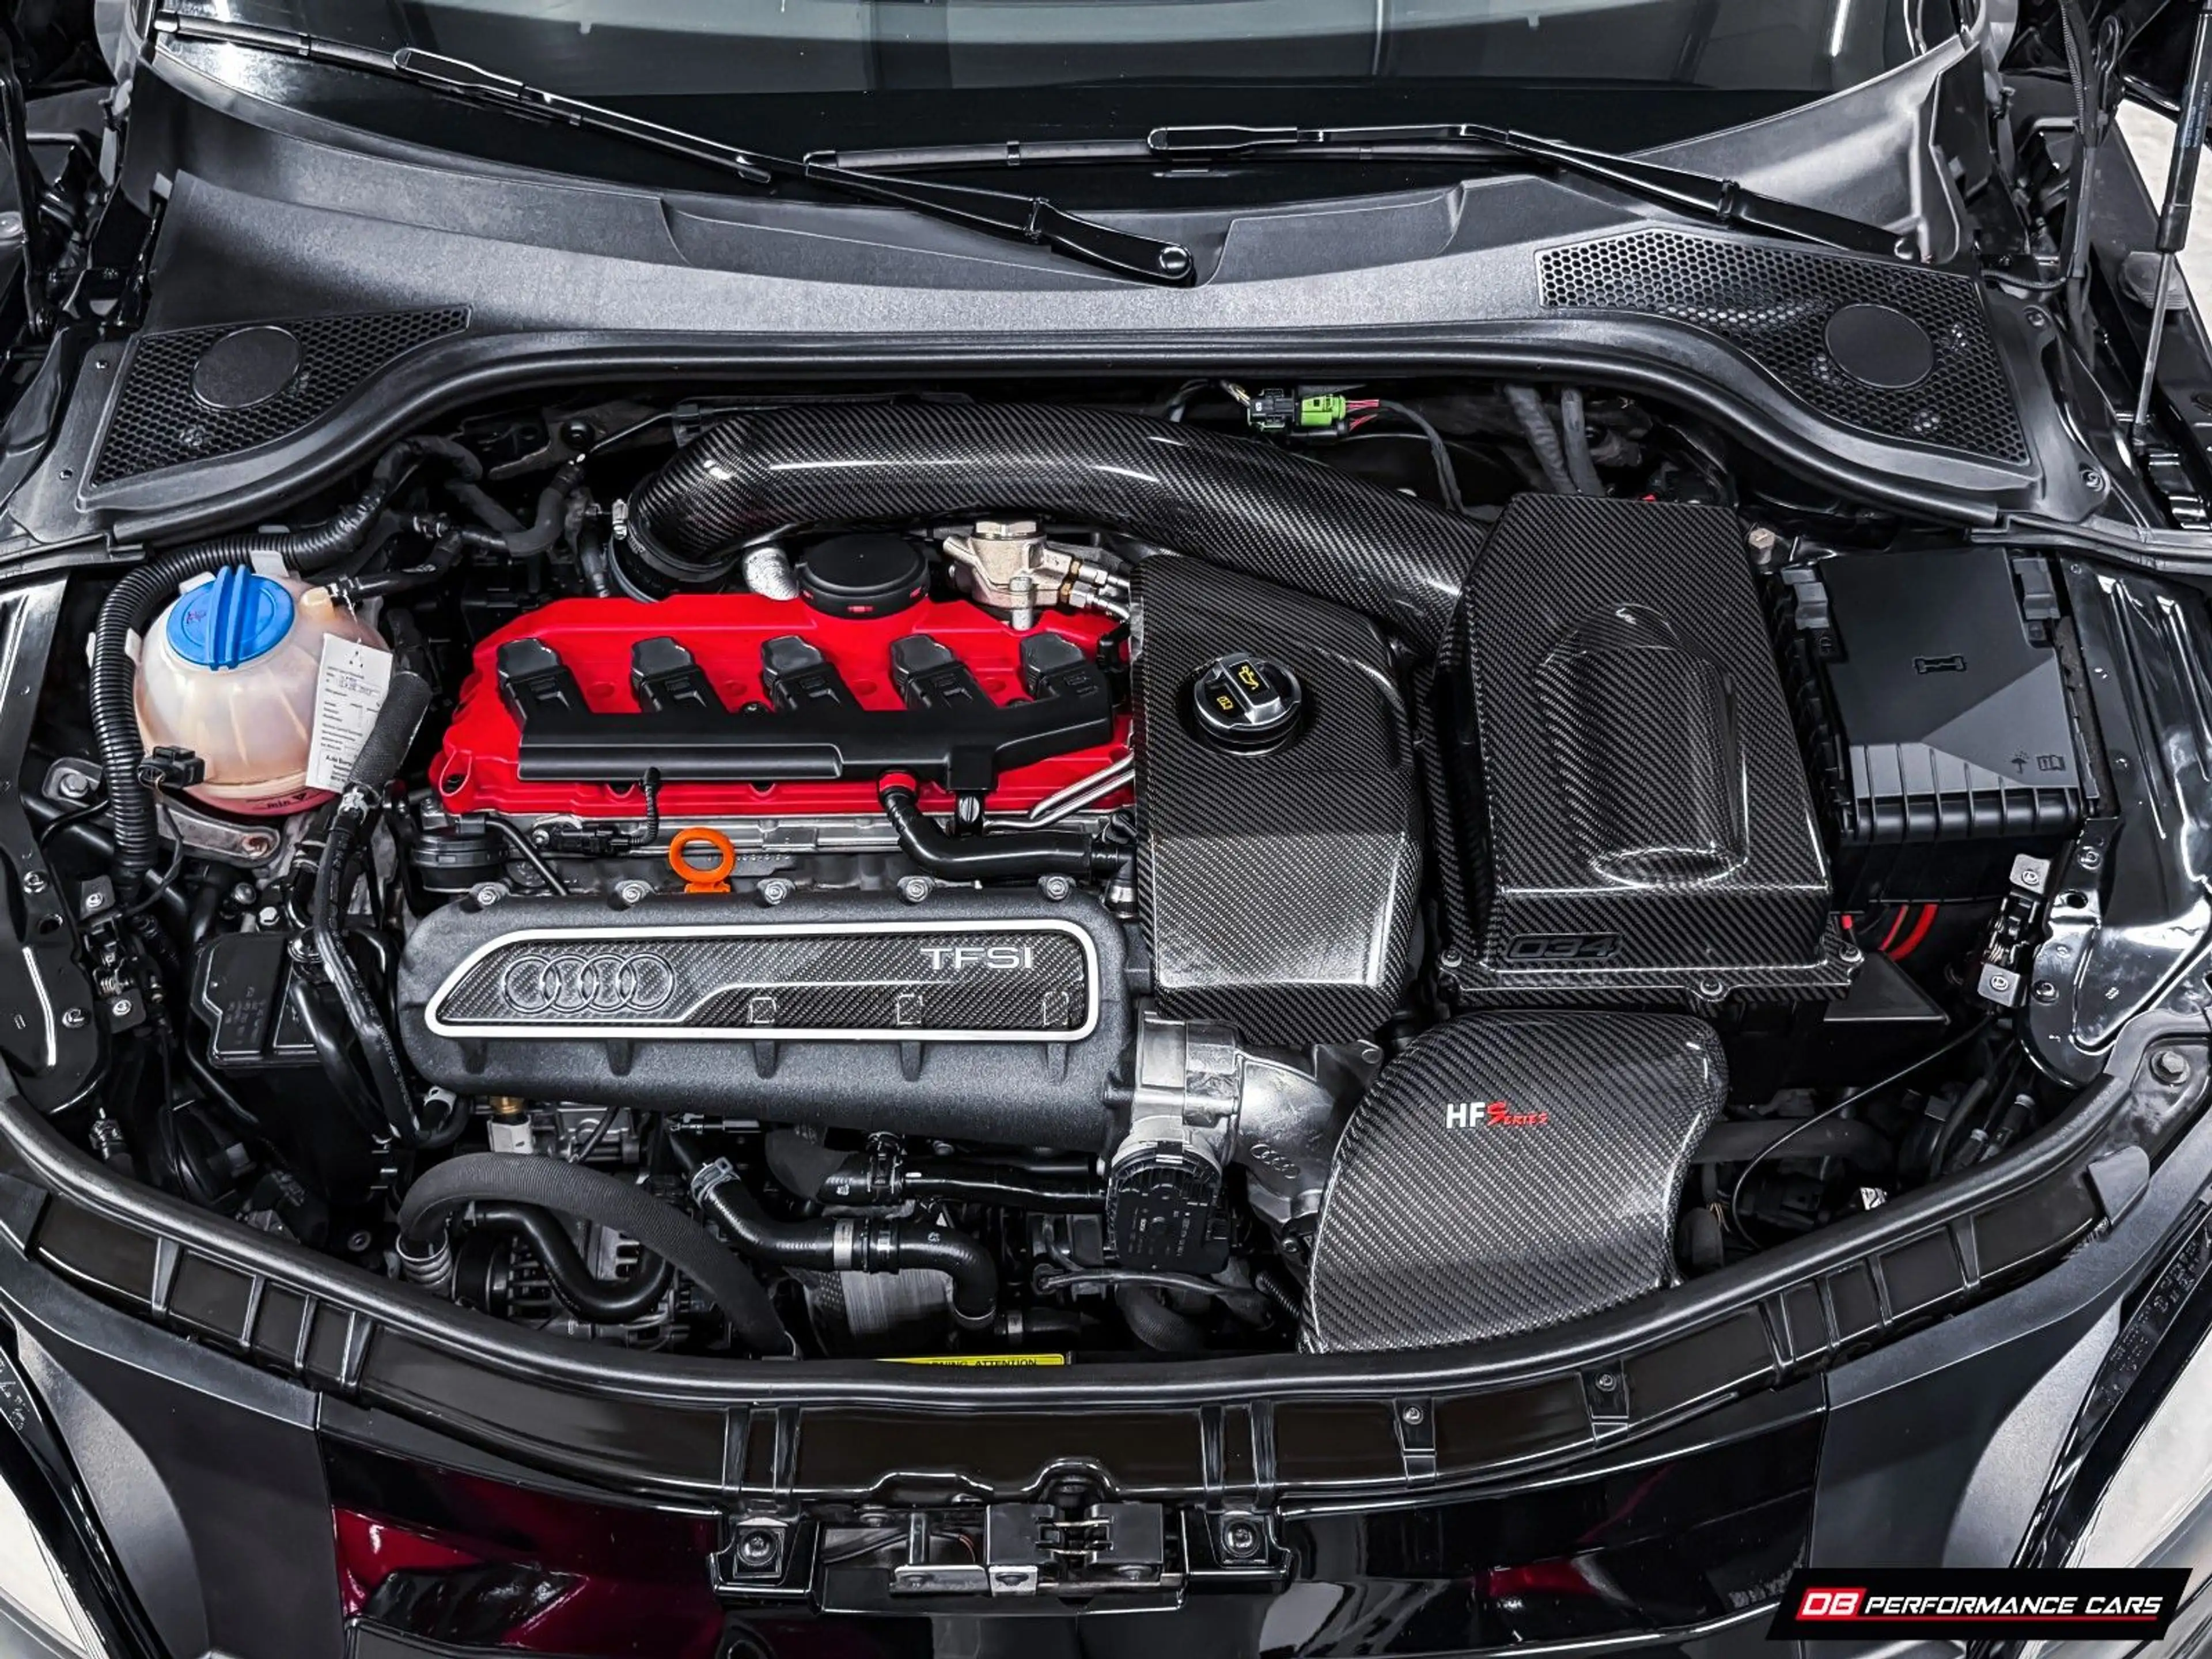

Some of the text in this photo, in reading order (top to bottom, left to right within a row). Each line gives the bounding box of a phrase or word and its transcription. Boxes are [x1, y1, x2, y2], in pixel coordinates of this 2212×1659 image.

[267, 799, 291, 809] min
[920, 945, 1033, 970] TFSI
[1509, 936, 1614, 958] 034
[1446, 1101, 1486, 1129] HF
